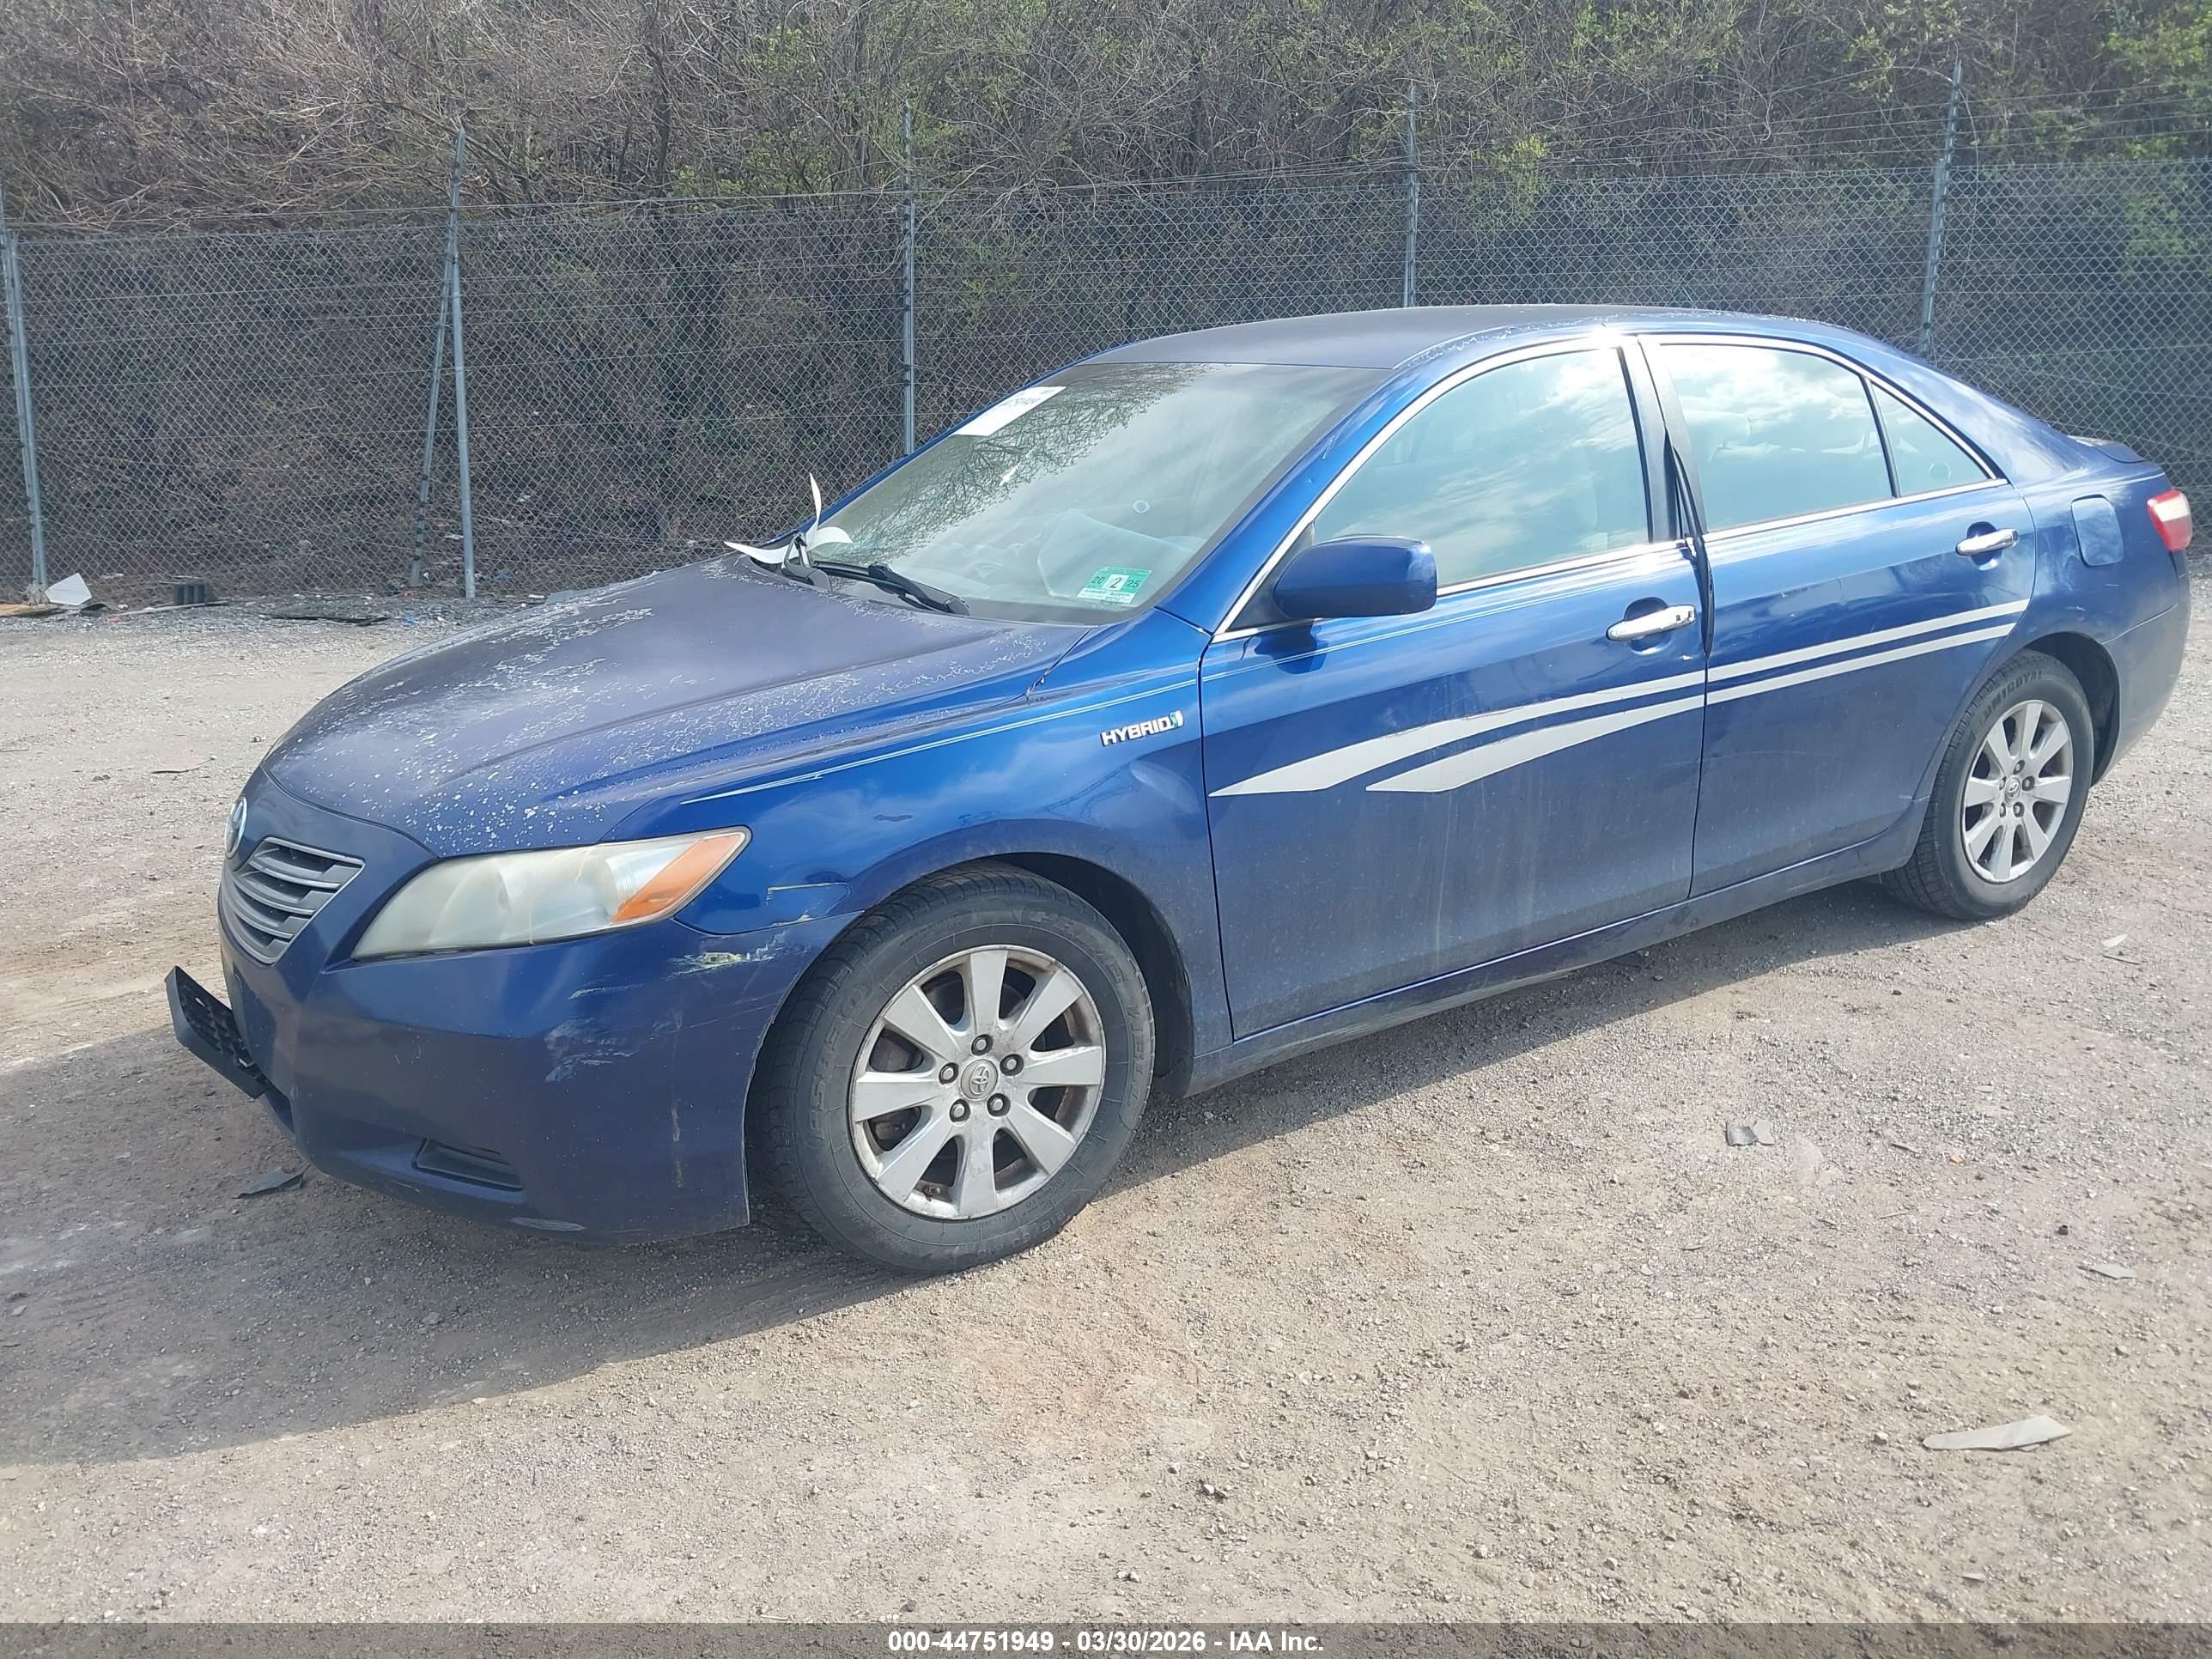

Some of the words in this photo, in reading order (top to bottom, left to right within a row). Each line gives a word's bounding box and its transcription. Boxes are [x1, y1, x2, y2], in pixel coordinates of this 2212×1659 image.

[1091, 576, 1105, 585] 20
[1109, 576, 1122, 589] 2
[1126, 579, 1140, 588] 25
[1100, 716, 1174, 746] HYBRID
